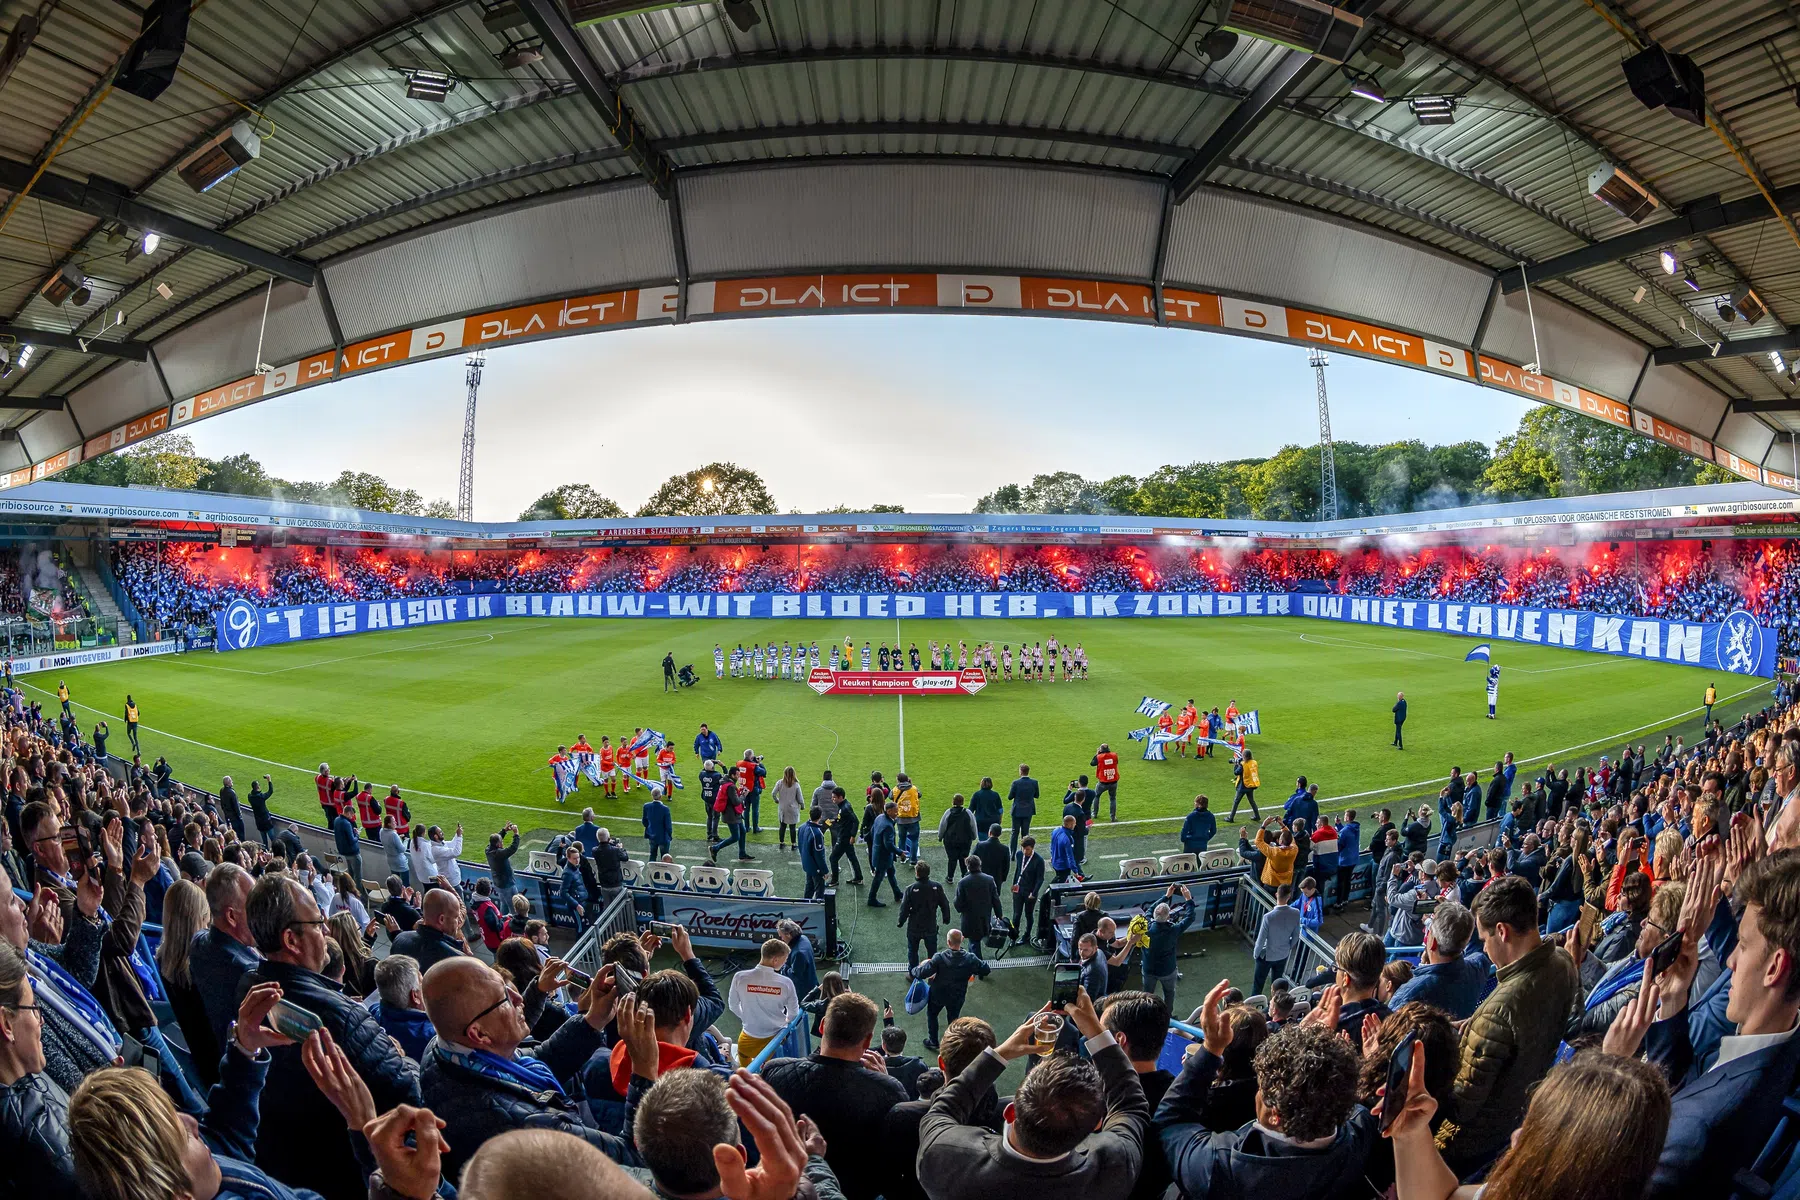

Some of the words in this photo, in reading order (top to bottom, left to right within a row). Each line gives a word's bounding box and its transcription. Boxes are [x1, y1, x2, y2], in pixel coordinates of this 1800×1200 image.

[740, 285, 826, 306] DLA
[842, 283, 910, 303] ICT
[1047, 288, 1130, 312] DLA
[480, 316, 546, 340] DLA
[557, 302, 615, 327] ICT
[1305, 319, 1365, 348] DLA
[1372, 333, 1412, 359] ICT
[357, 341, 396, 366] ICT
[1479, 361, 1516, 387] DLA
[1519, 373, 1545, 395] ICT
[200, 393, 227, 413] DLA
[230, 381, 256, 401] ICT
[1586, 397, 1611, 417] DLA
[1613, 407, 1630, 424] ICT
[129, 422, 149, 438] DLA
[149, 412, 167, 430] ICT
[1656, 425, 1675, 443] DLA
[1674, 434, 1689, 447] ICT
[80, 506, 180, 519] www.agribiosource.com
[205, 512, 260, 524] agribiosource
[1513, 517, 1523, 525] UW
[1523, 515, 1557, 524] OPLOSSING
[1557, 514, 1575, 523] VOOR
[1576, 511, 1619, 522] ORGANISCHE
[1619, 508, 1672, 519] RESTSTROMEN
[1707, 501, 1794, 514] www.agribiosource.com
[286, 519, 296, 527] UW
[297, 519, 331, 529] OPLOSSING
[331, 521, 348, 530] VOOR
[348, 522, 382, 532] ORGANISCHE
[382, 524, 417, 535] RESTSTROMEN
[608, 528, 646, 536] ARENDSEN
[651, 527, 689, 535] STAALBOUW
[317, 604, 356, 634] IS
[367, 598, 458, 628] ALSOF
[467, 596, 492, 617] IK
[505, 594, 757, 618] BLAUW-WIT
[771, 594, 927, 617] BLOED
[1073, 594, 1120, 617] IK
[1132, 594, 1292, 616] ZONDER
[1302, 596, 1344, 619] OW
[1352, 598, 1418, 627] NIET
[1427, 604, 1579, 647] LEAVEN
[1591, 617, 1703, 663] KAN
[53, 651, 112, 667] MDHUITGEVERIJ
[842, 679, 870, 687] Keuken
[872, 679, 910, 688] Kampioen
[672, 907, 818, 934] Roelofswaad
[747, 986, 781, 995] voetbalshop
